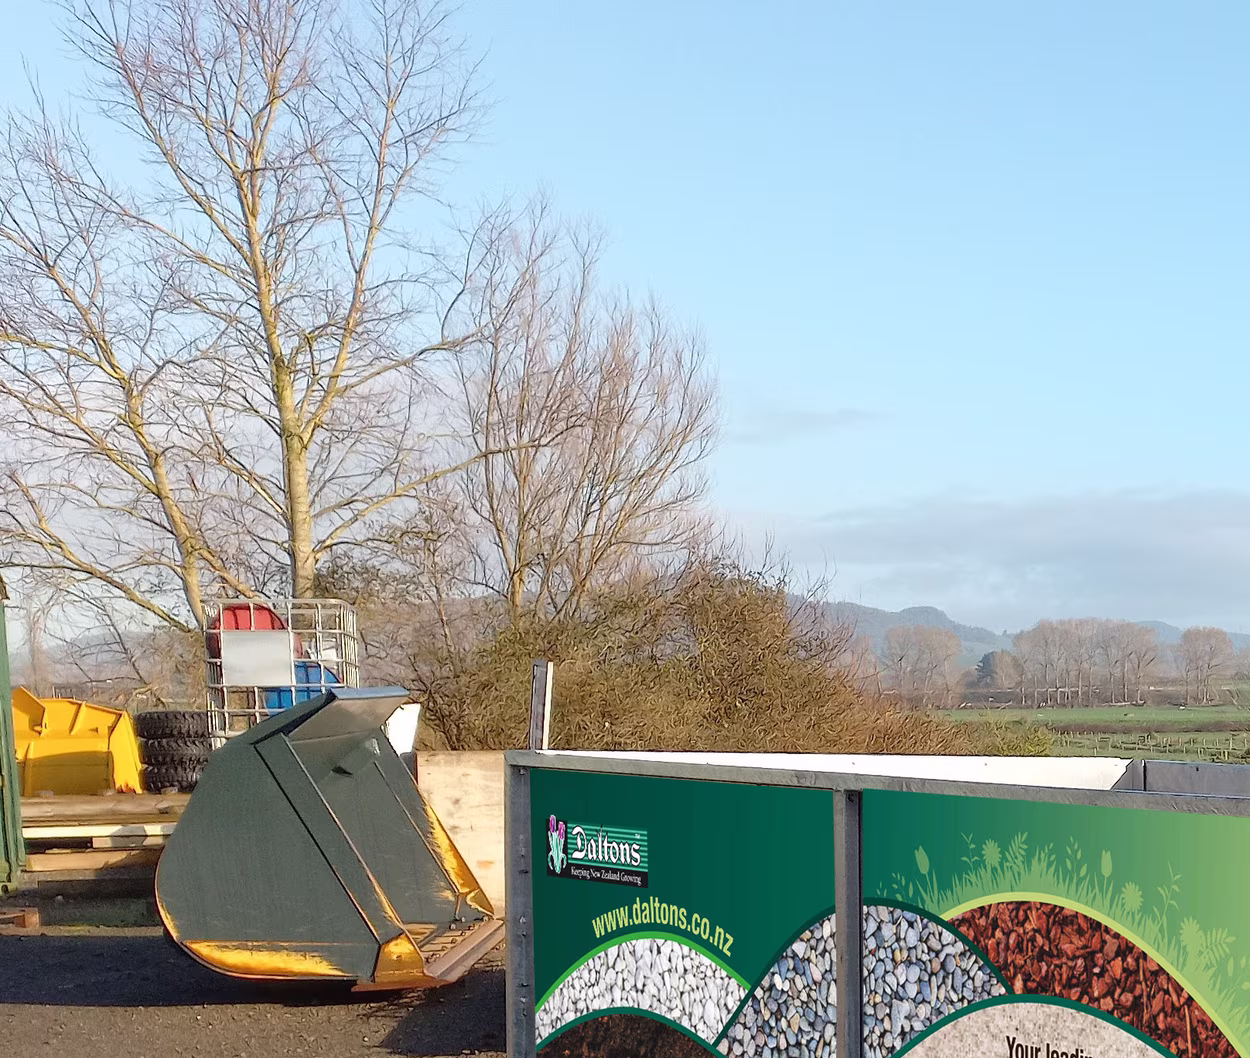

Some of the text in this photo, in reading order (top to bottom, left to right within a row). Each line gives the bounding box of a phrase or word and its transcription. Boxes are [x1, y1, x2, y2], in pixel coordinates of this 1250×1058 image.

[571, 825, 641, 866] Daltons
[571, 866, 642, 886] Keeping New Zealand Growing
[592, 896, 735, 957] www.daltons.co.nz
